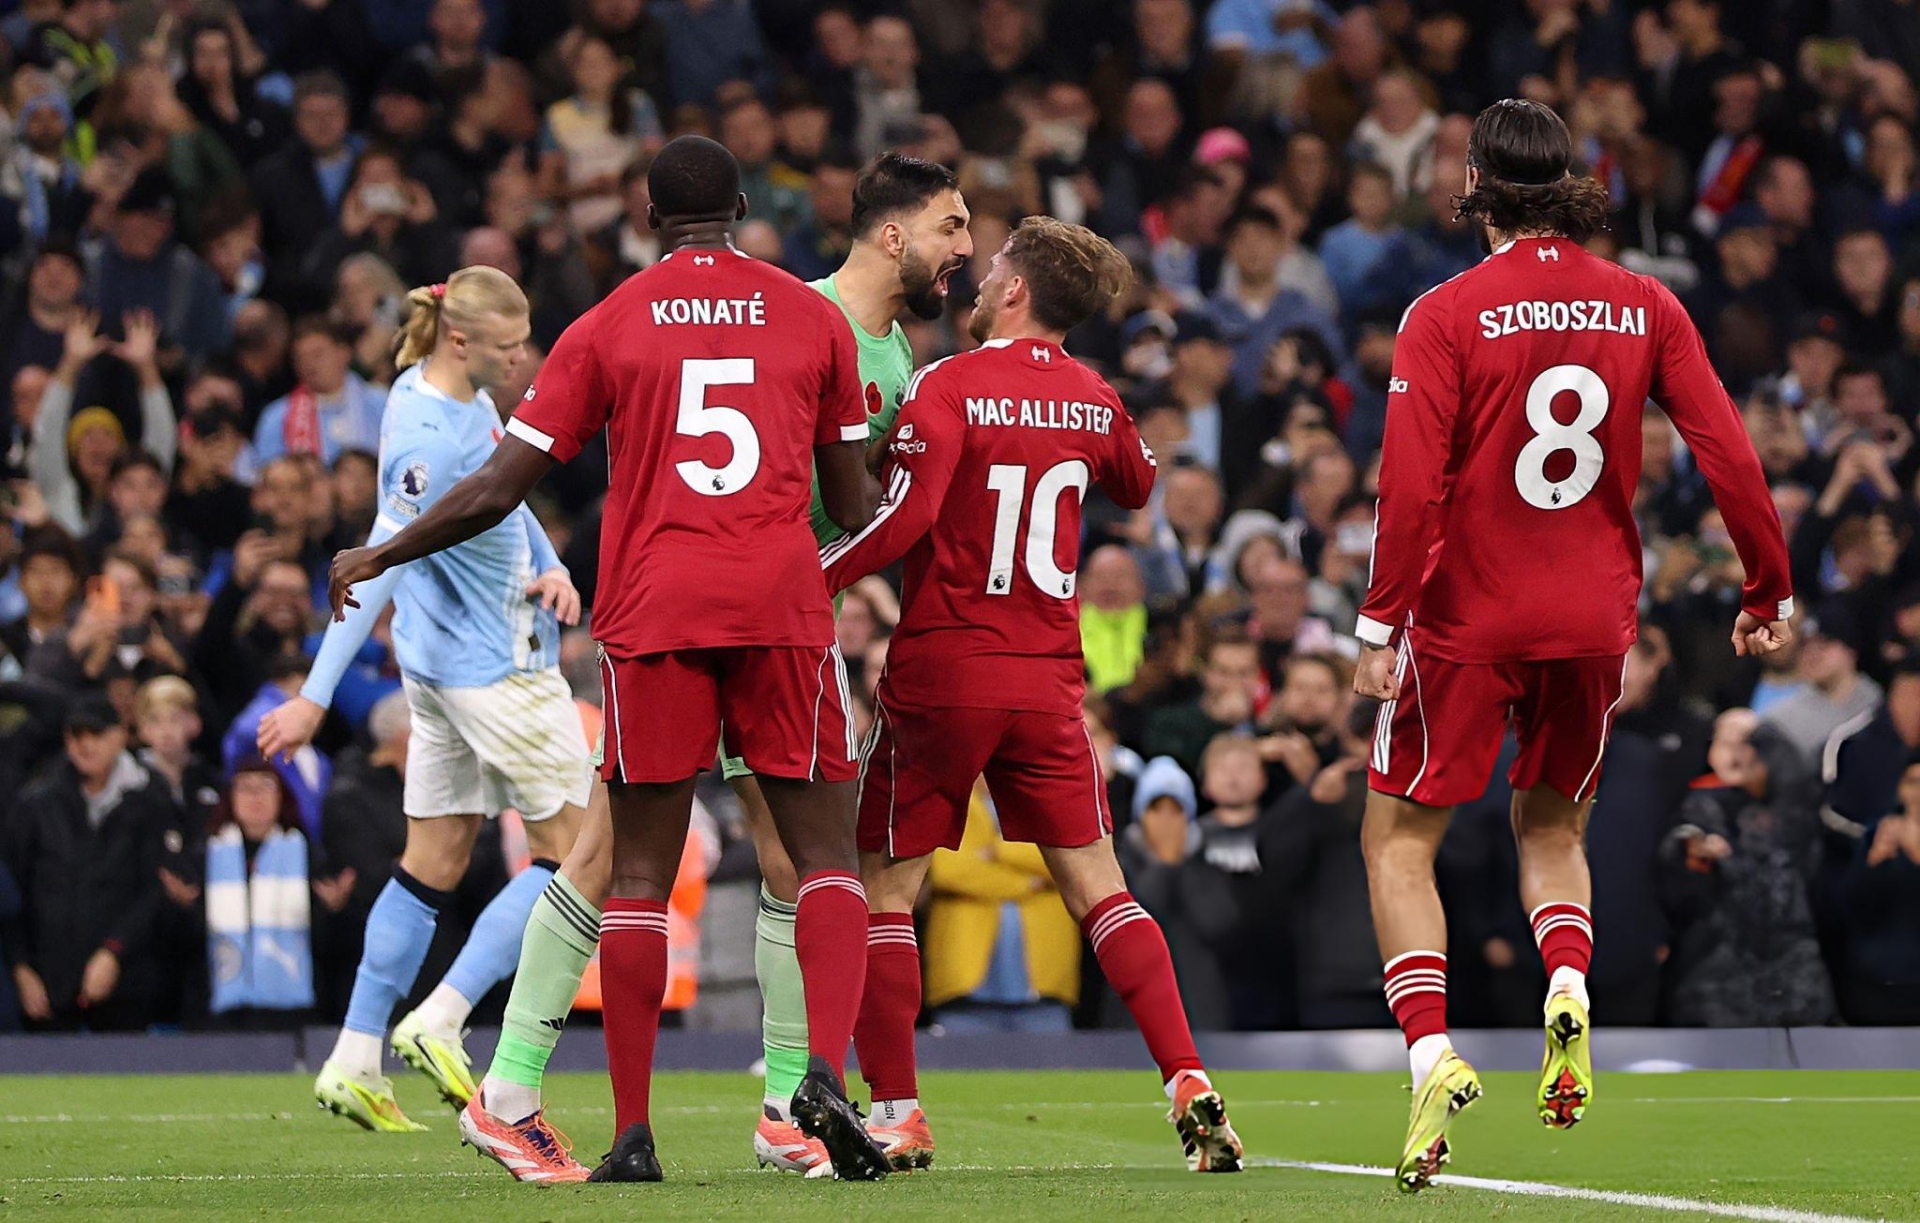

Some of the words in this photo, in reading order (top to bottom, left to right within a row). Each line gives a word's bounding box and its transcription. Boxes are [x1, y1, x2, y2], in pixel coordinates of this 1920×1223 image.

[650, 291, 766, 325] KONATÉ
[1479, 300, 1646, 339] SZOBOSZLAI
[675, 357, 761, 496] 5
[965, 397, 1016, 426] MAC
[1019, 399, 1113, 435] ALLISTER
[1514, 364, 1609, 510] 8
[985, 459, 1089, 600] 10
